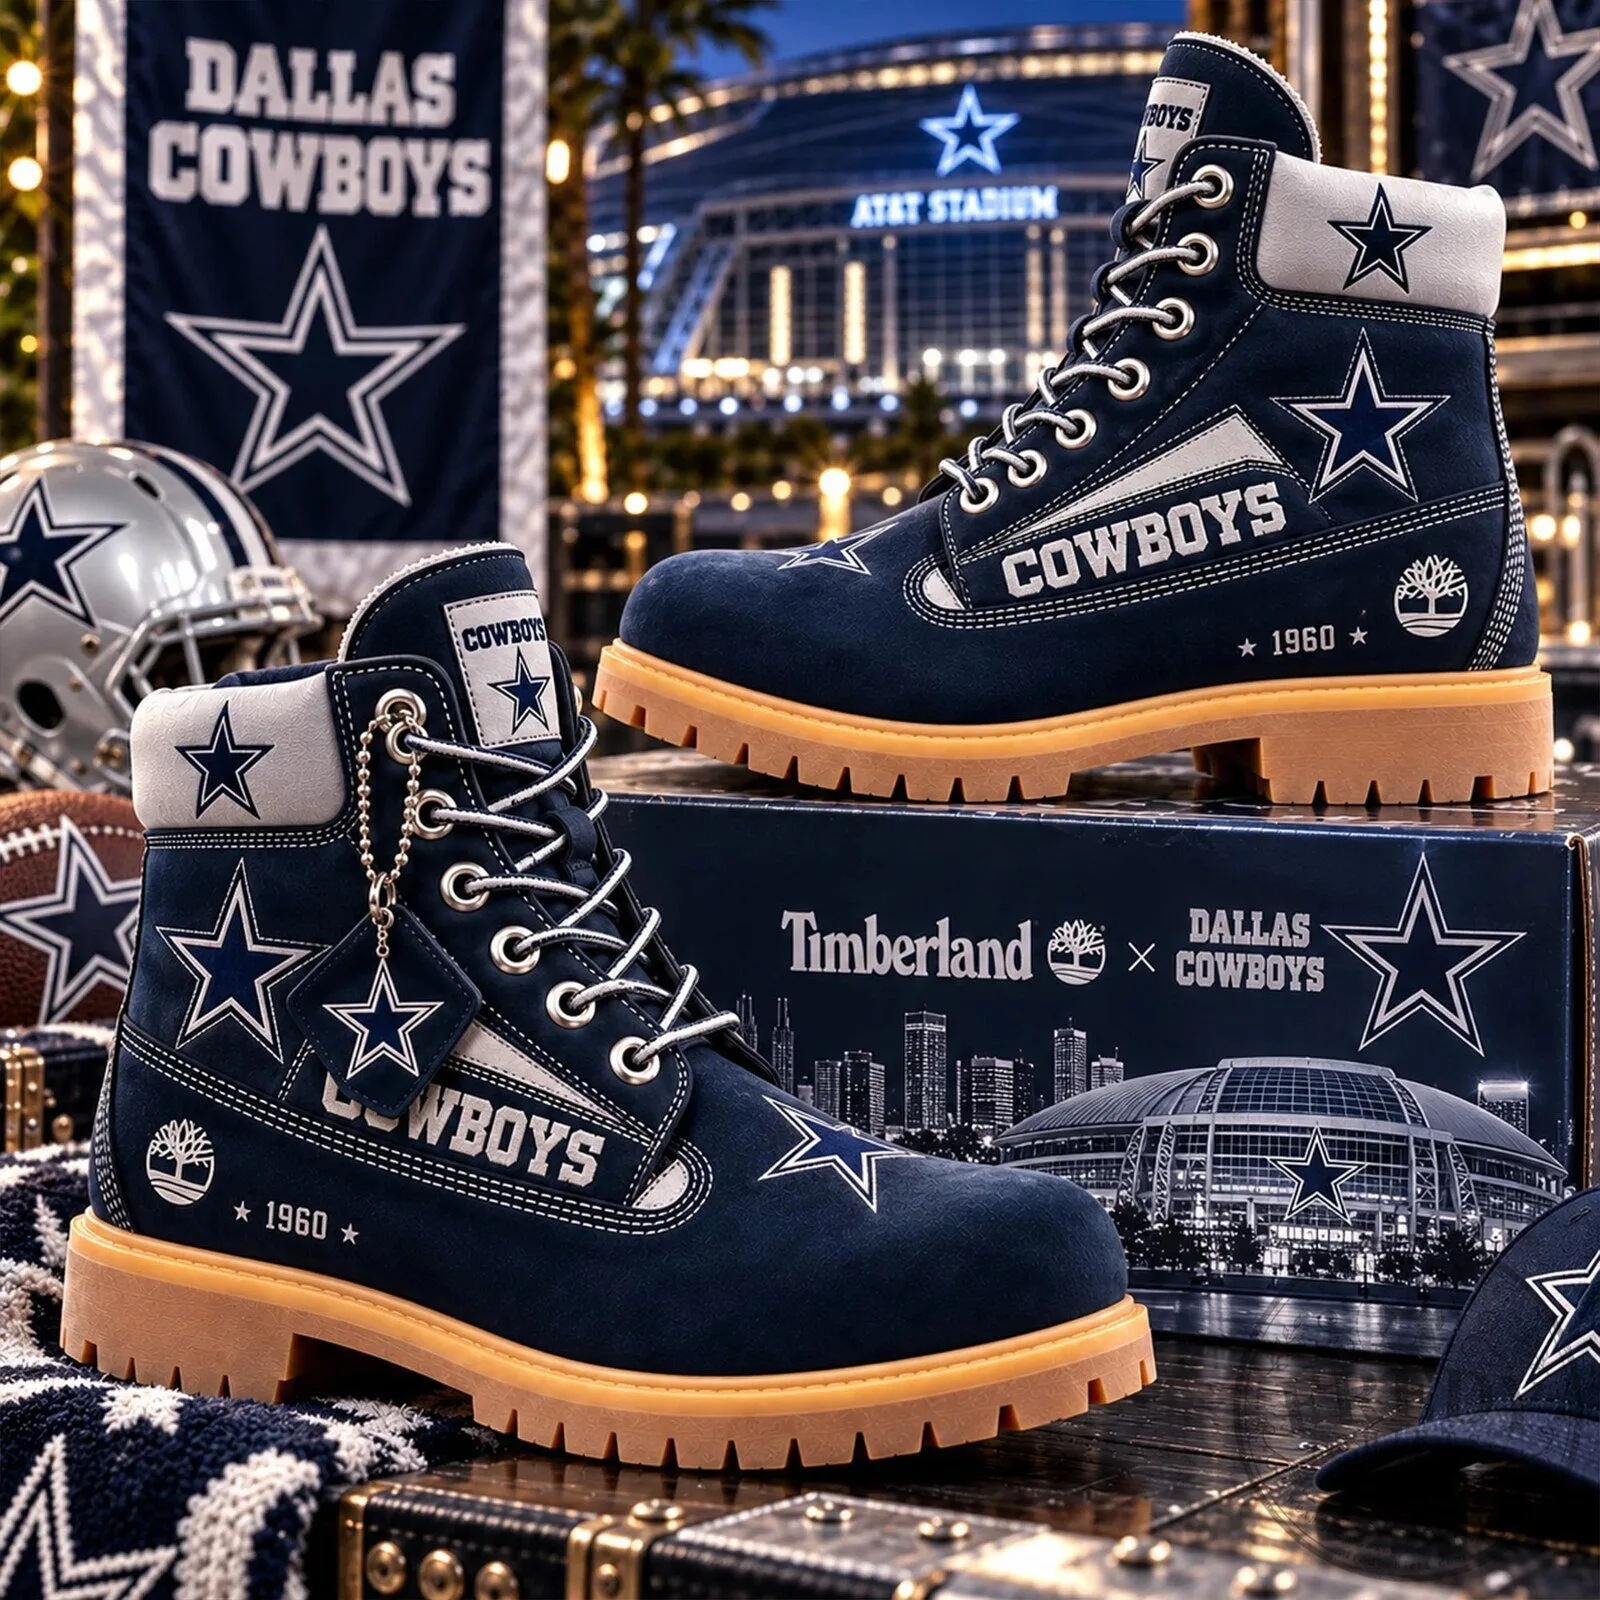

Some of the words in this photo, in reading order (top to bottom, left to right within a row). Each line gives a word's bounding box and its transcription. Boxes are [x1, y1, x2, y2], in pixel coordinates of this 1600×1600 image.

[185, 37, 456, 127] DALLAS
[1141, 103, 1194, 132] BOYS
[148, 121, 491, 217] COWBOYS
[850, 191, 924, 228] AT&T
[927, 184, 1059, 224] STADIUM
[1001, 481, 1287, 598] COWBOYS
[461, 616, 546, 652] COWBOYS
[1271, 624, 1336, 656] 1960
[780, 909, 1034, 981] Timberland
[1189, 907, 1311, 948] DALLAS
[1175, 950, 1325, 993] COWBOYS
[321, 1072, 606, 1188] CWBOYS
[264, 1200, 329, 1240] 1960
